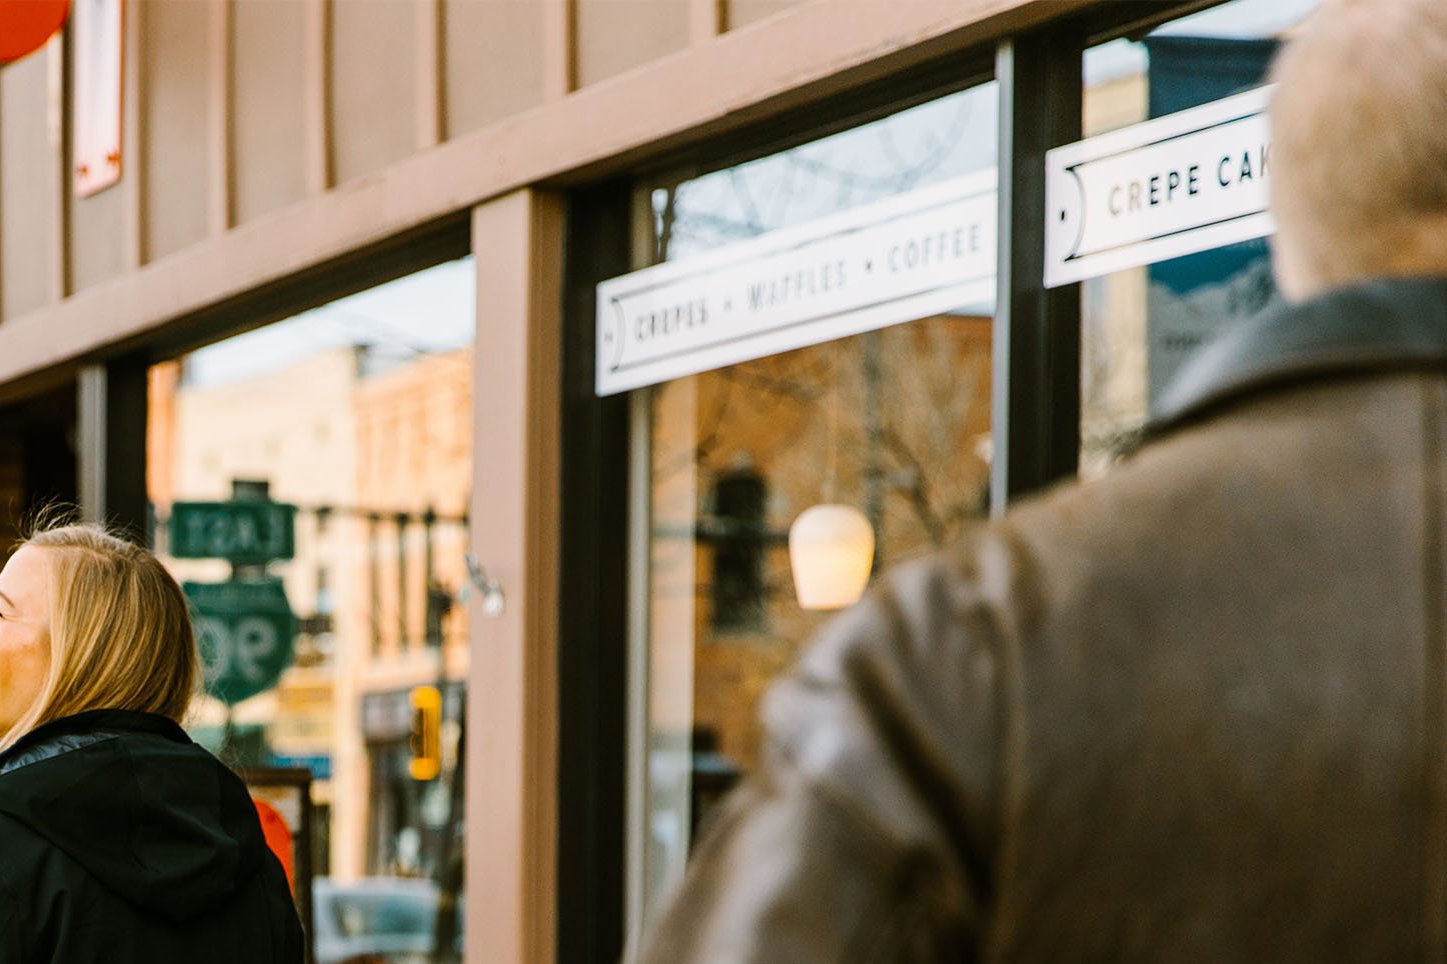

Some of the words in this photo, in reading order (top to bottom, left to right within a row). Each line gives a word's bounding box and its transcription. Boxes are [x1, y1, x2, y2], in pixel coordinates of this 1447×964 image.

[1107, 164, 1199, 216] CREPE
[634, 297, 710, 343] CREPES
[748, 259, 848, 311] WAFFLES
[887, 223, 981, 274] COFFEE
